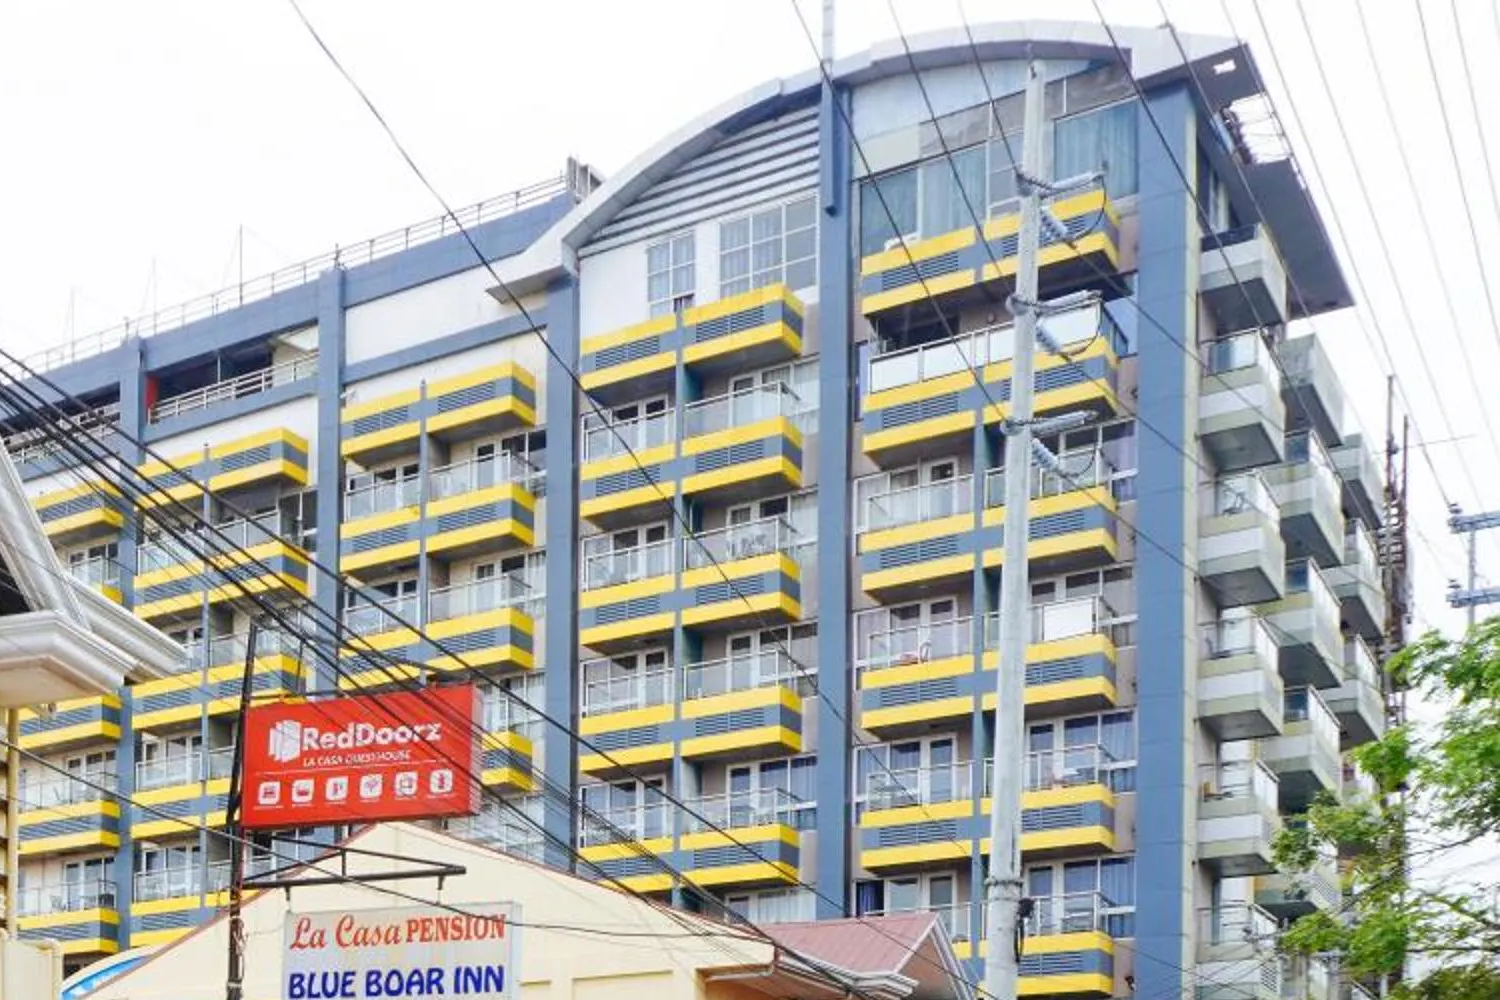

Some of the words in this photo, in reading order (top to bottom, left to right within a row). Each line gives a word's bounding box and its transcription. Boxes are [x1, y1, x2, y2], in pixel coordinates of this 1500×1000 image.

[303, 721, 442, 751] RedDoorz
[303, 757, 316, 768] LA
[290, 916, 326, 949] La
[335, 913, 400, 948] Casa
[405, 914, 506, 942] PENSION
[289, 971, 357, 999] BLUE
[365, 967, 445, 997] BOAR
[454, 965, 505, 994] INN
